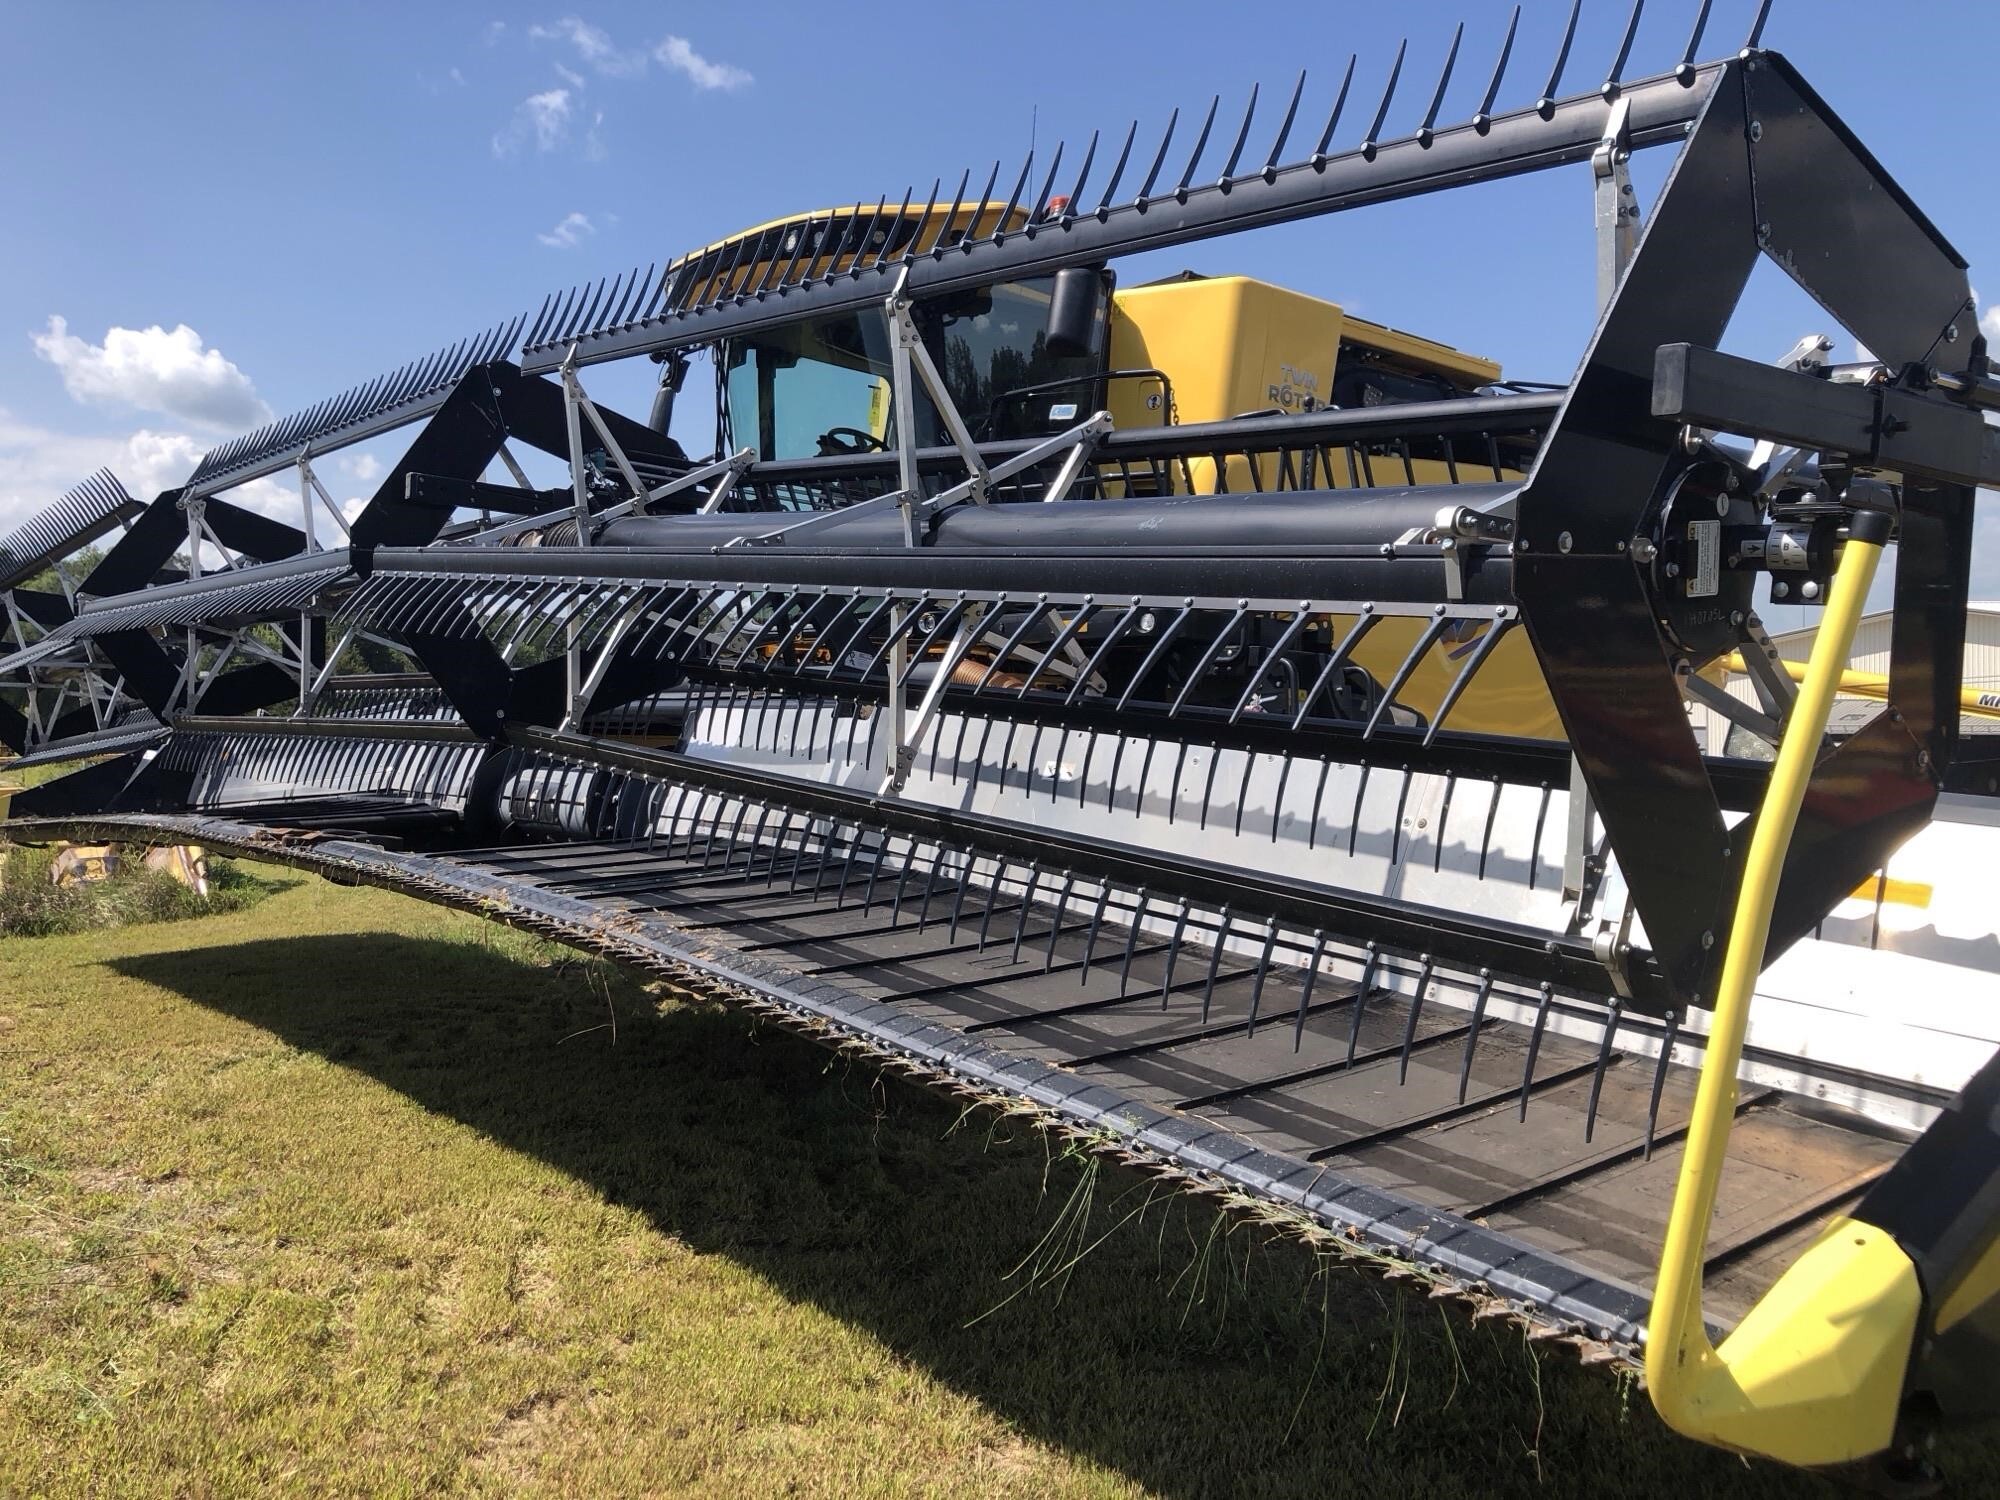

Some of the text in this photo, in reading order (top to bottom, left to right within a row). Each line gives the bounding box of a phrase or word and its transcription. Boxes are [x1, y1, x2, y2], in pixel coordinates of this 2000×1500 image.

[1280, 364, 1319, 391] TWIN
[1268, 383, 1326, 412] ROTR
[1783, 543, 1789, 551] B
